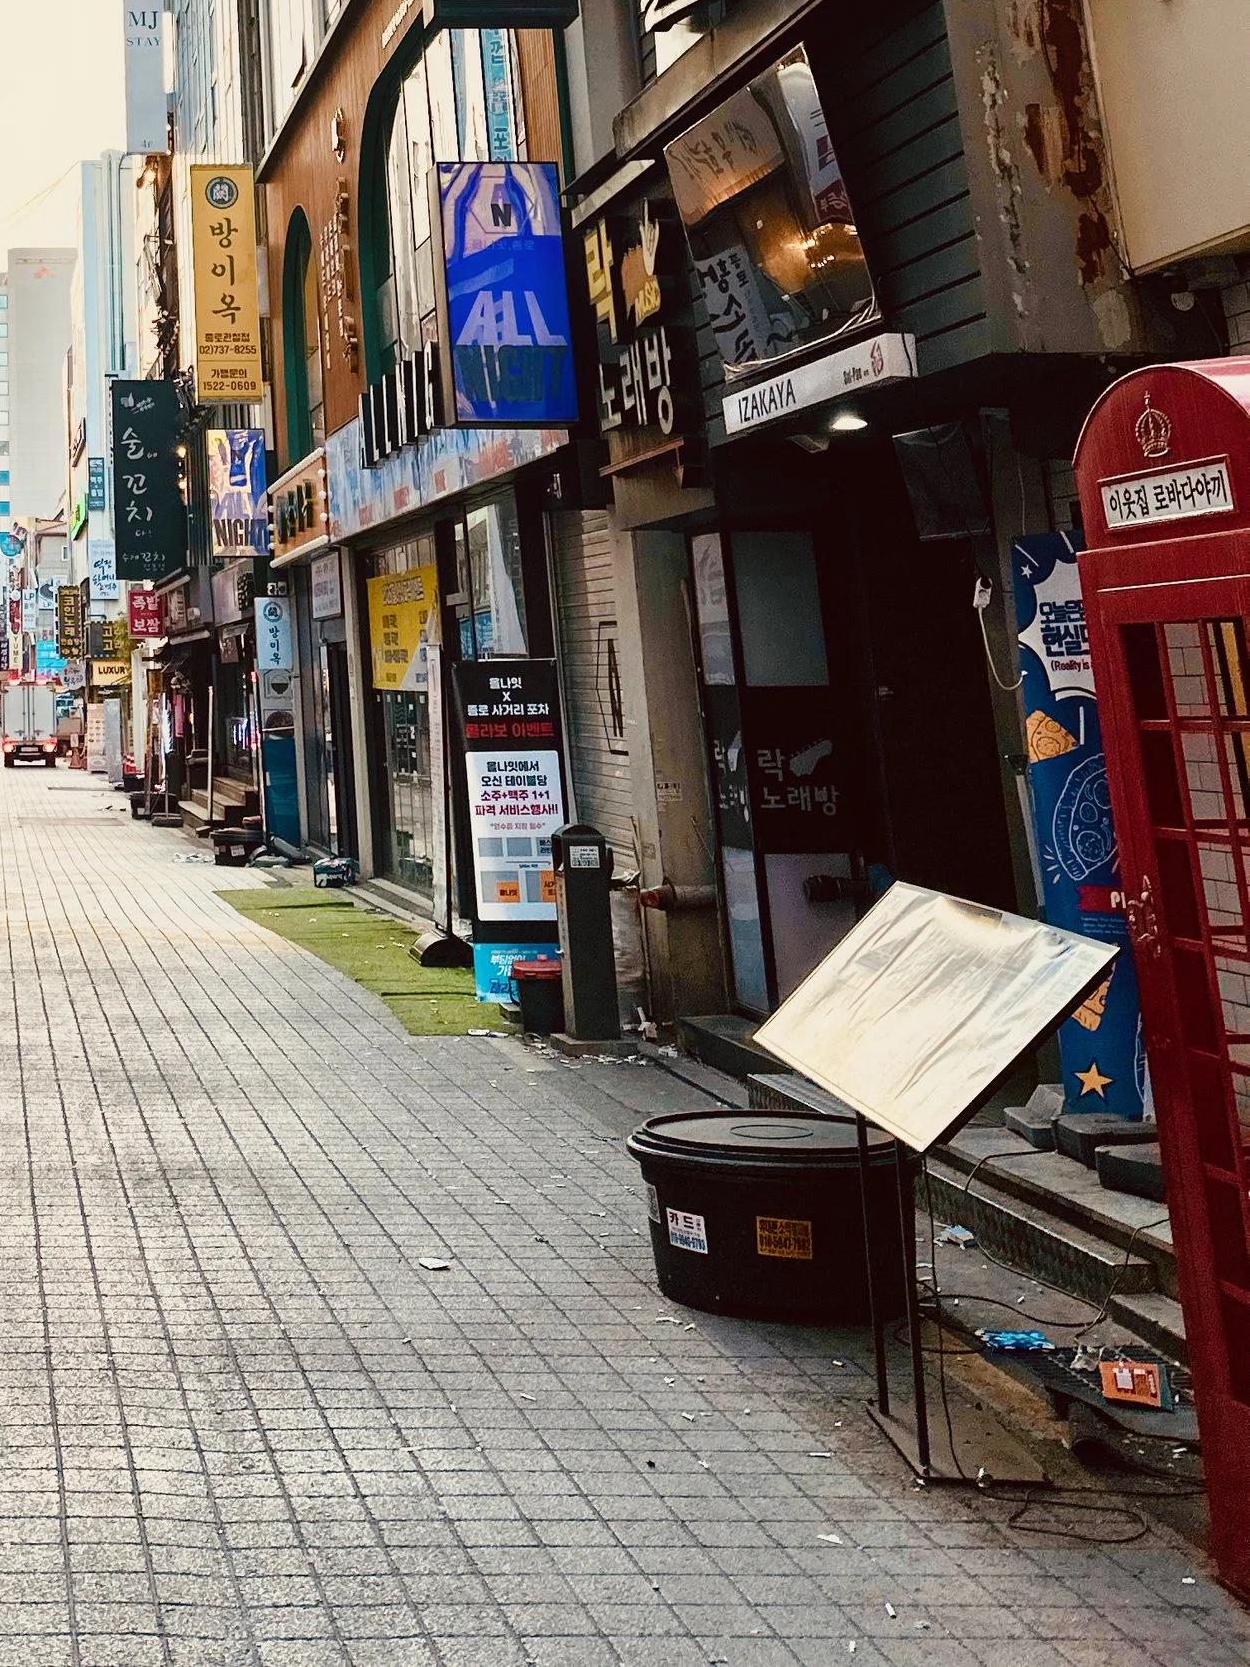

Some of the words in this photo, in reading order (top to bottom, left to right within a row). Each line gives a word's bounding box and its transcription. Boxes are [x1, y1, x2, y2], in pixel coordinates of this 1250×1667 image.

[127, 11, 159, 30] MJ
[125, 37, 162, 47] STAY
[208, 217, 242, 326] 방이옥
[455, 290, 569, 347] ALL
[198, 343, 258, 355] 02)737-8255
[202, 380, 258, 391] 1522-0609
[737, 378, 797, 424] IZAKAYA
[1107, 481, 1152, 523] 이웃집
[1153, 469, 1228, 512] 로바다야끼
[132, 595, 161, 611] 족발
[132, 618, 161, 634] 보쌈
[1050, 659, 1082, 672] (Reality
[491, 704, 525, 717] 사거리
[526, 702, 550, 716] 포차
[511, 721, 555, 737] 이벤트
[756, 747, 787, 782] 락
[480, 775, 503, 788] 오신
[531, 790, 551, 801] 1+1
[760, 784, 840, 816] 노래방
